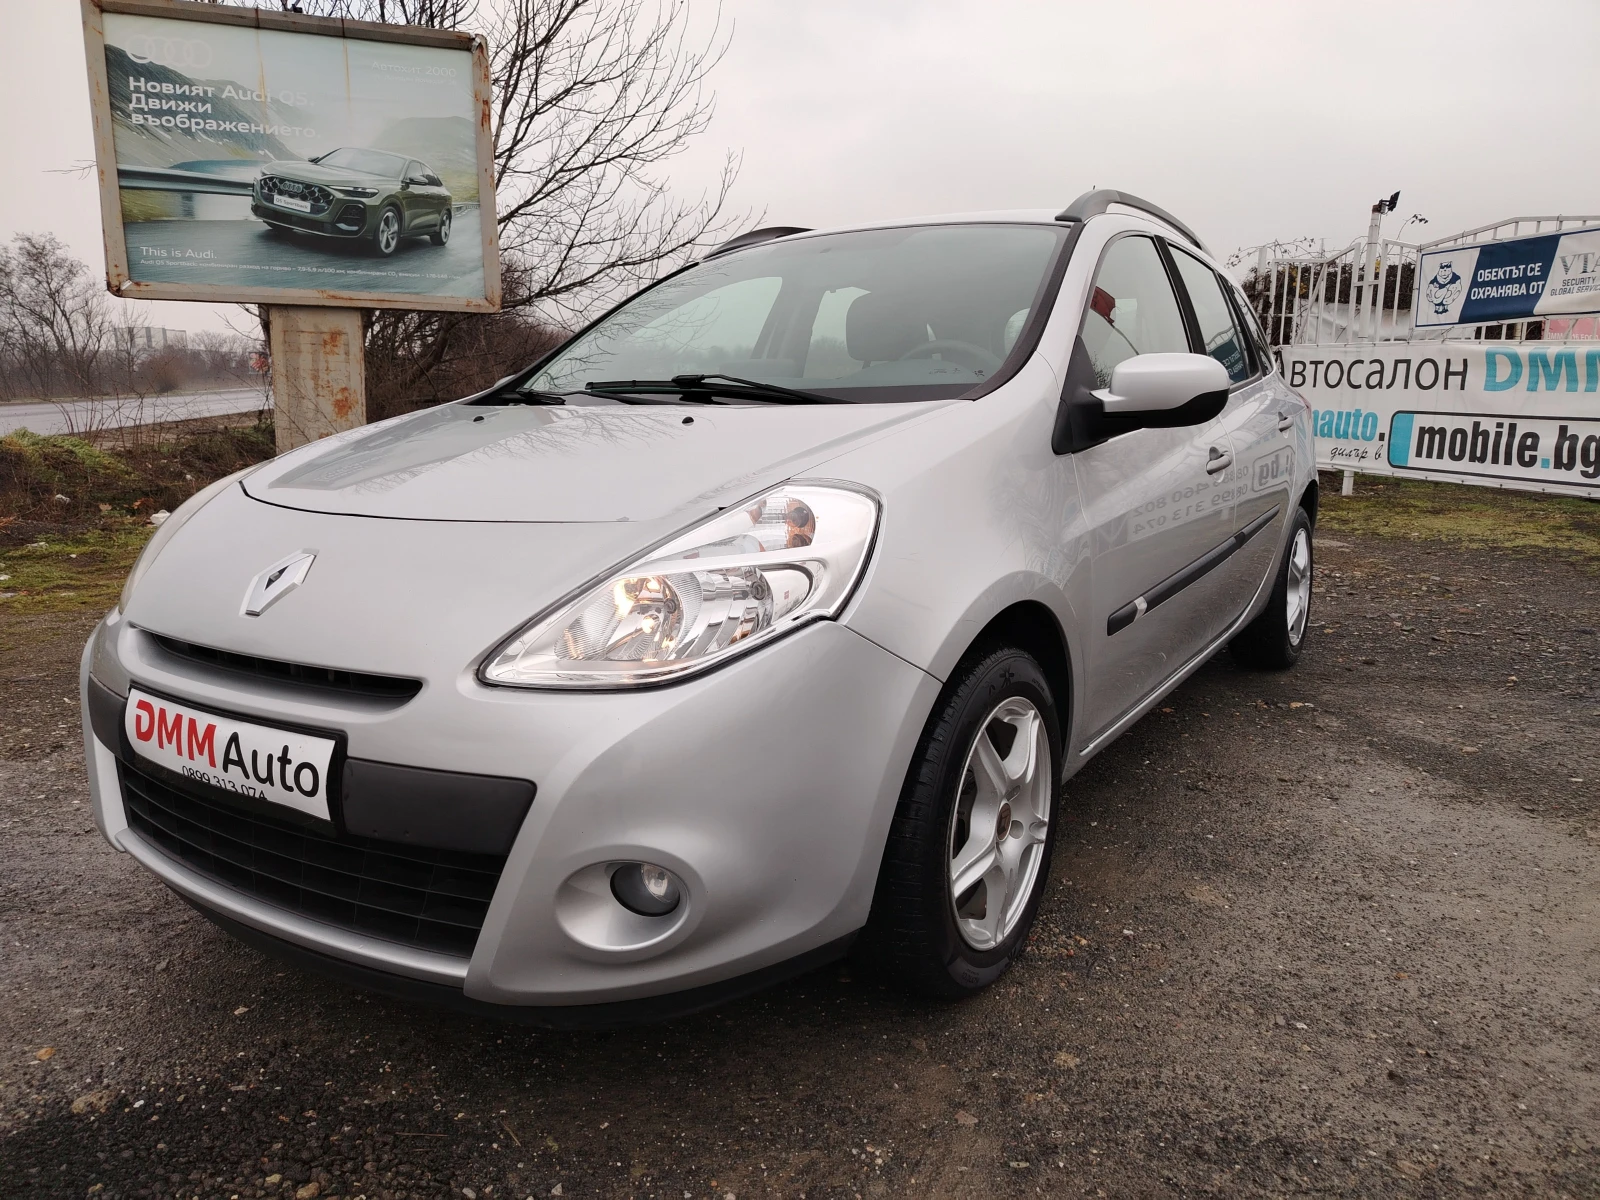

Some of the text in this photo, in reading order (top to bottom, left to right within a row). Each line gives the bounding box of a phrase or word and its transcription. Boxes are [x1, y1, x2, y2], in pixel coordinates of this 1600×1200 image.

[425, 66, 457, 77] 2000
[128, 76, 216, 98] Новият
[221, 84, 272, 103] Audi
[128, 93, 212, 114] Движи
[130, 113, 321, 139] въображението.
[140, 246, 217, 259] This is Audi.
[1477, 262, 1543, 282] ОБЕКТЪТ СЕ
[1561, 276, 1597, 288] SECURITY
[1470, 280, 1545, 300] ОХРАНЯВА ОТ
[1550, 287, 1574, 297] GLOBAL
[1415, 420, 1600, 479] mobile.bg
